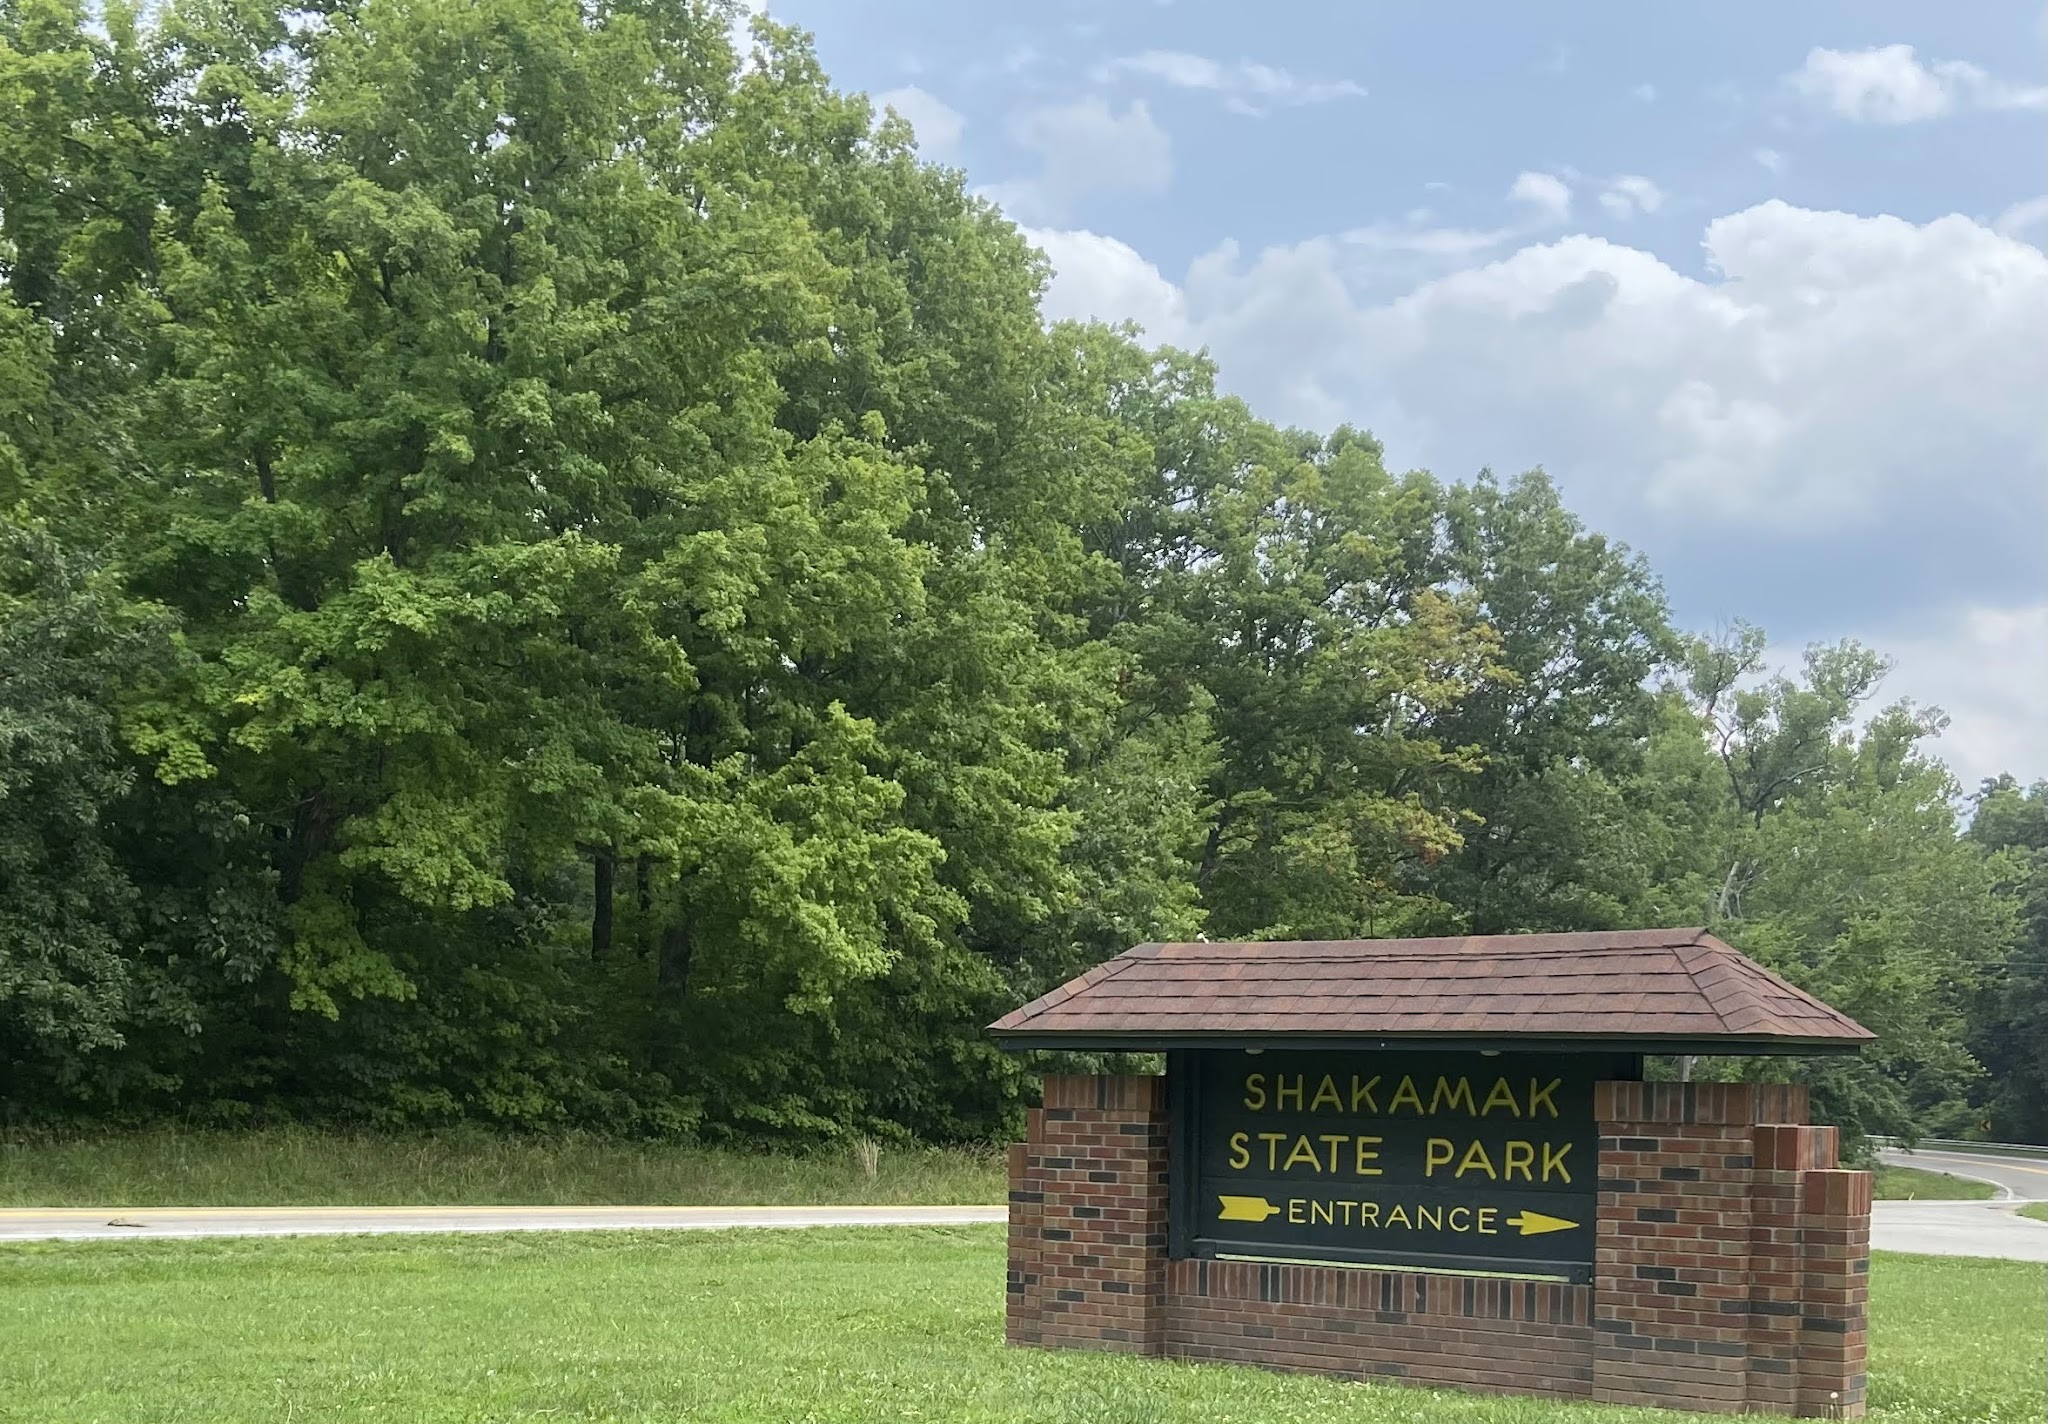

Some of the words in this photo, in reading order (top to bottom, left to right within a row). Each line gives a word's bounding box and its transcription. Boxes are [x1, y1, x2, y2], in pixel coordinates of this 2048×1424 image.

[1244, 1073, 1561, 1118] SHAKAMAK
[1228, 1131, 1383, 1175] STATE
[1425, 1137, 1573, 1183] PARK
[1288, 1198, 1498, 1234] ENTRANCE
